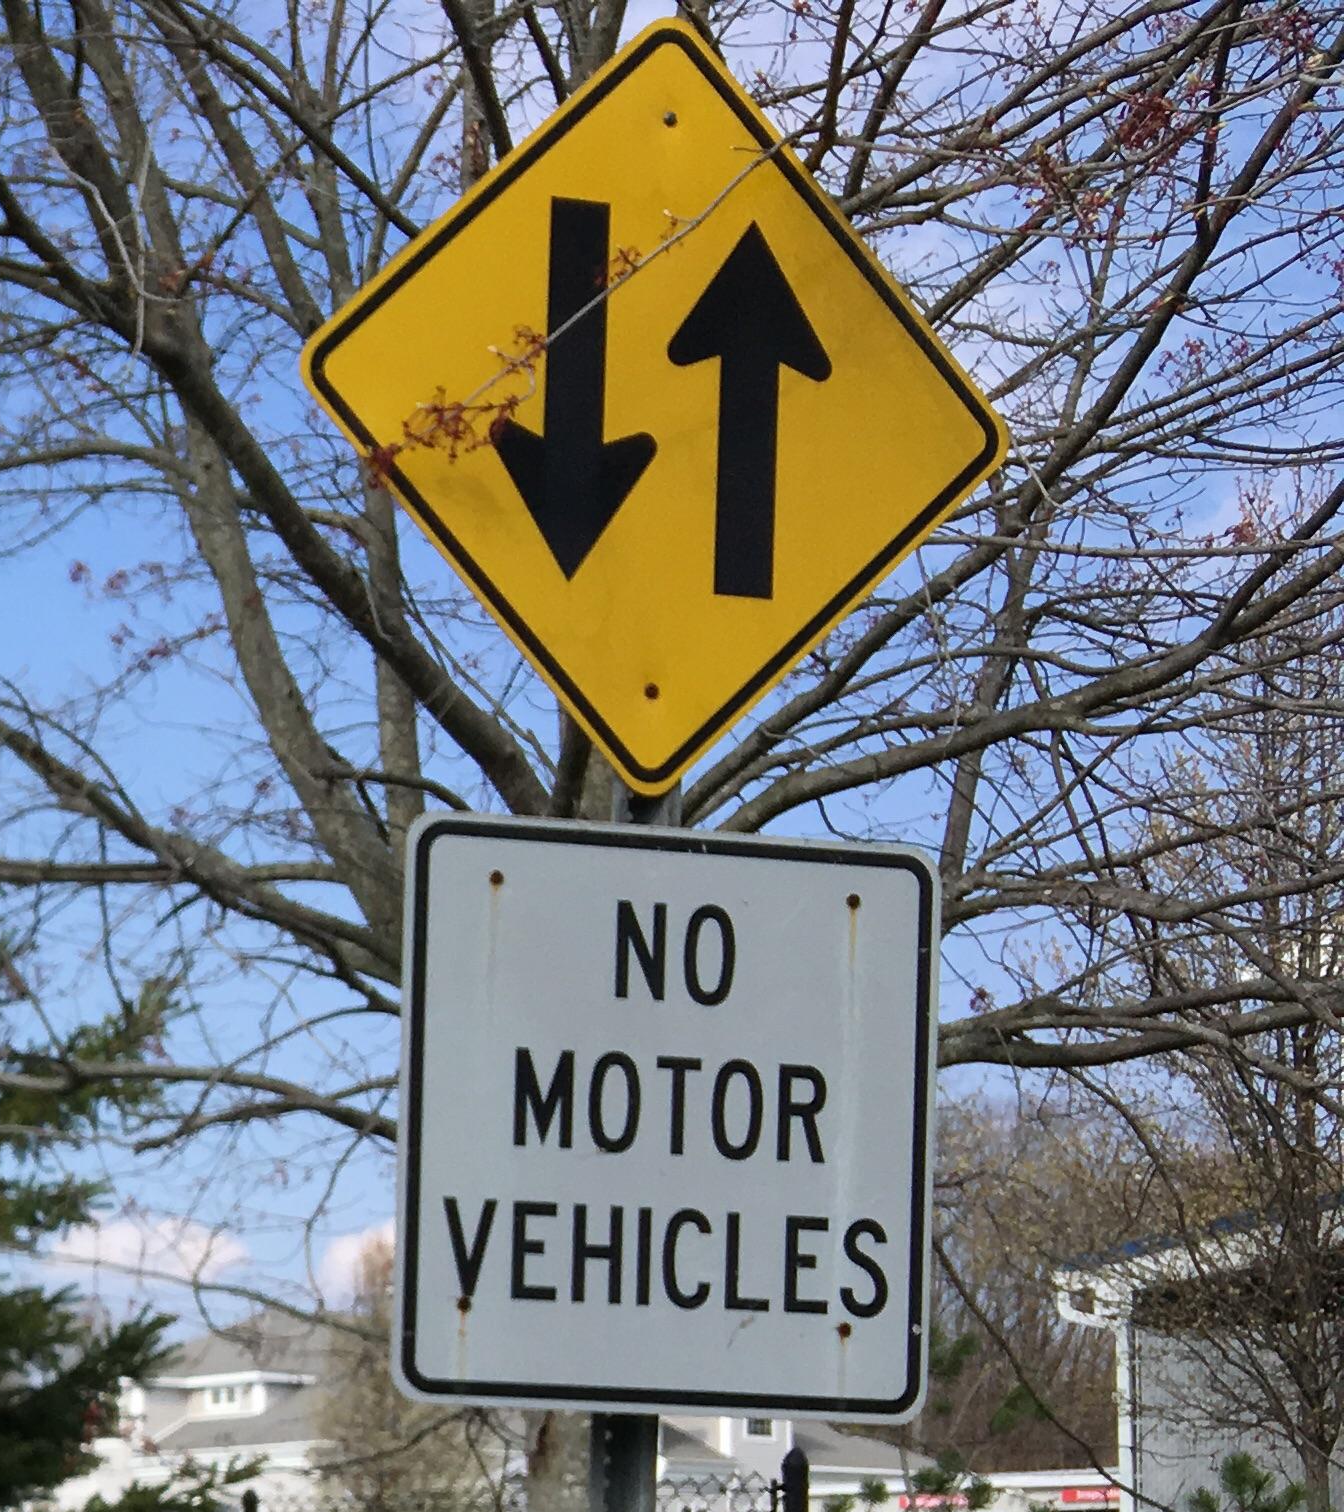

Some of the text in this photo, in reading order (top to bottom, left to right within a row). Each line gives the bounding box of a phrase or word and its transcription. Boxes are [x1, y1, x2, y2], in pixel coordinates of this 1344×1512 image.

[614, 899, 737, 1006] NO
[512, 1046, 828, 1164] MOTOR
[442, 1195, 890, 1319] VEHICLES
